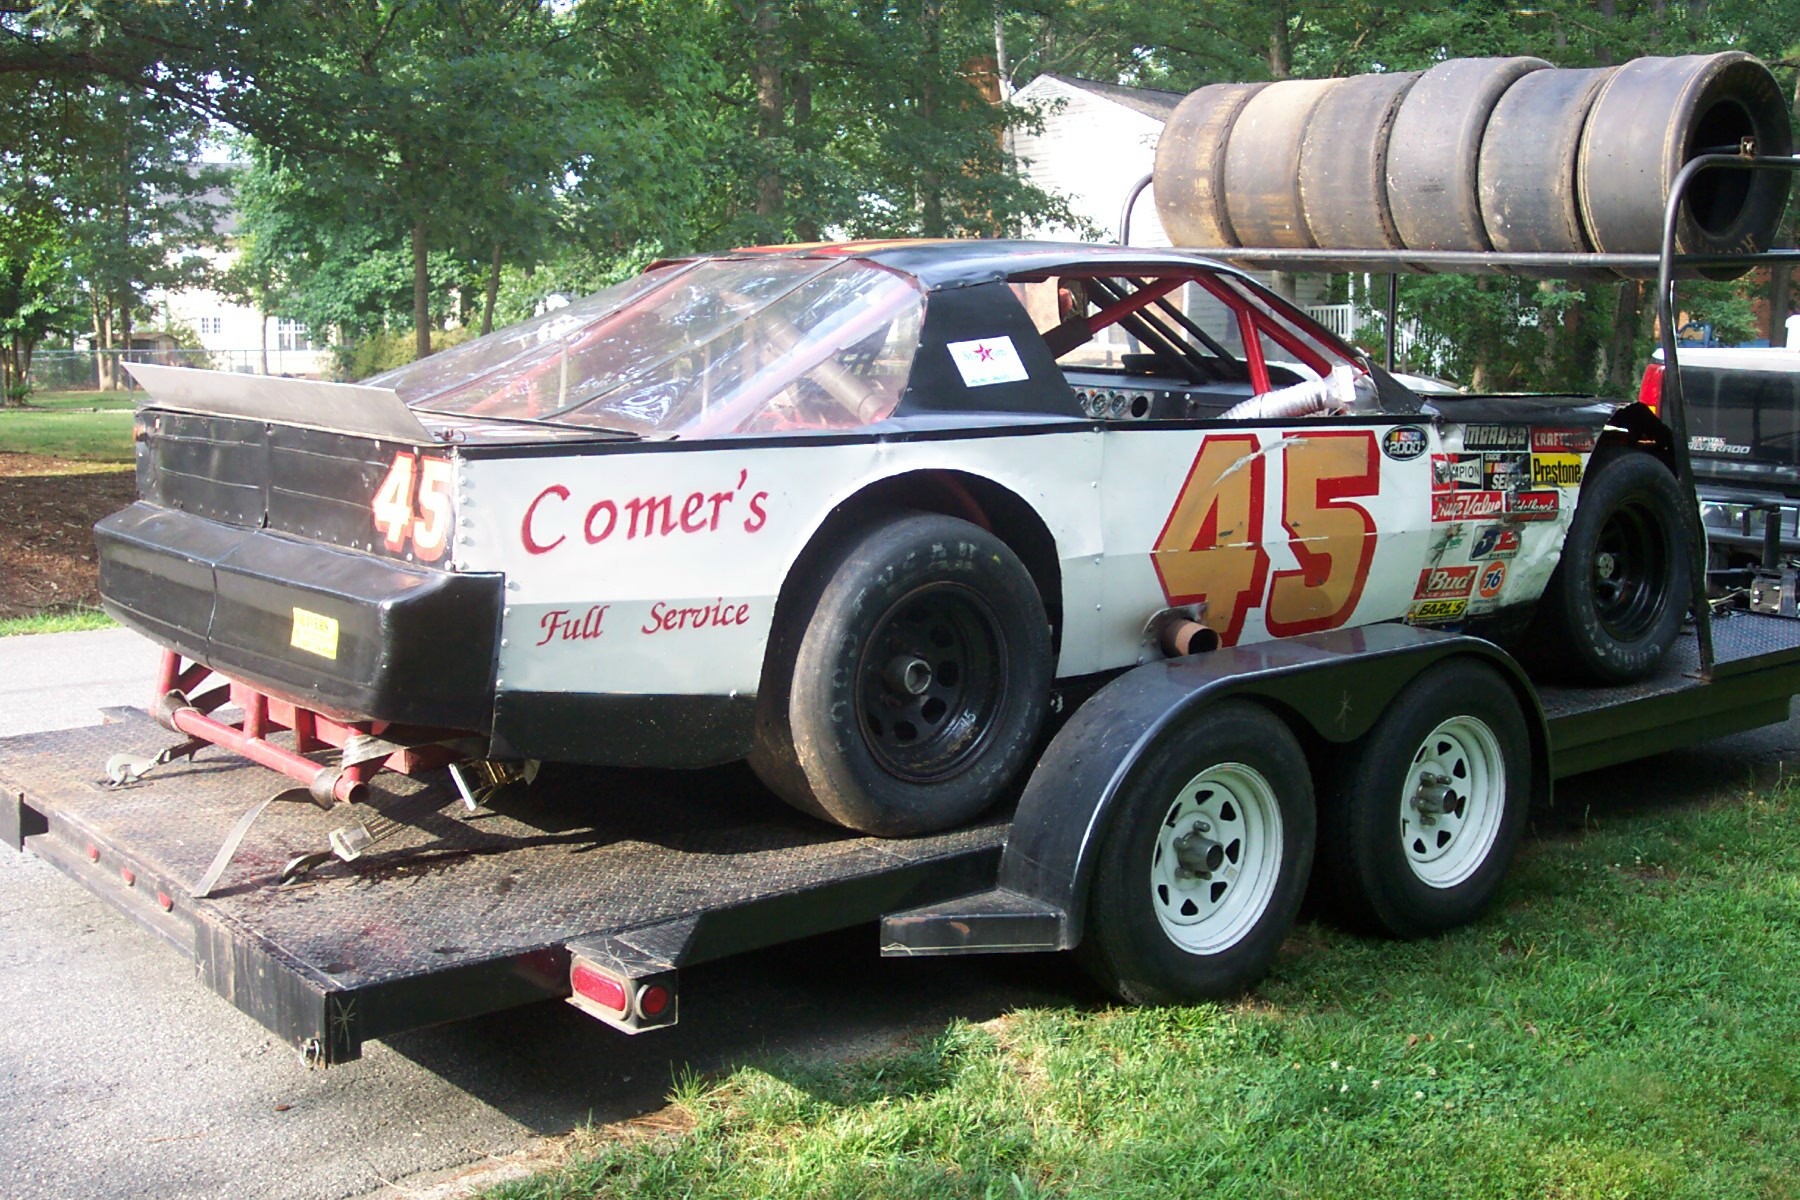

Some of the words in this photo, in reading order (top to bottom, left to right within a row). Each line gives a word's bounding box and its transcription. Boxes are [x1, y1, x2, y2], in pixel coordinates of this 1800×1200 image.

[1389, 441, 1421, 454] 2000
[1533, 457, 1582, 485] Prestone
[371, 451, 453, 562] 45
[521, 468, 769, 555] Comer's
[1432, 495, 1463, 520] True
[1456, 493, 1502, 518] Value
[1150, 430, 1380, 648] 45
[1426, 569, 1476, 593] Bud
[1482, 568, 1503, 589] 76
[535, 605, 610, 647] Full
[641, 596, 750, 636] Service
[1418, 601, 1466, 616] EARL'S
